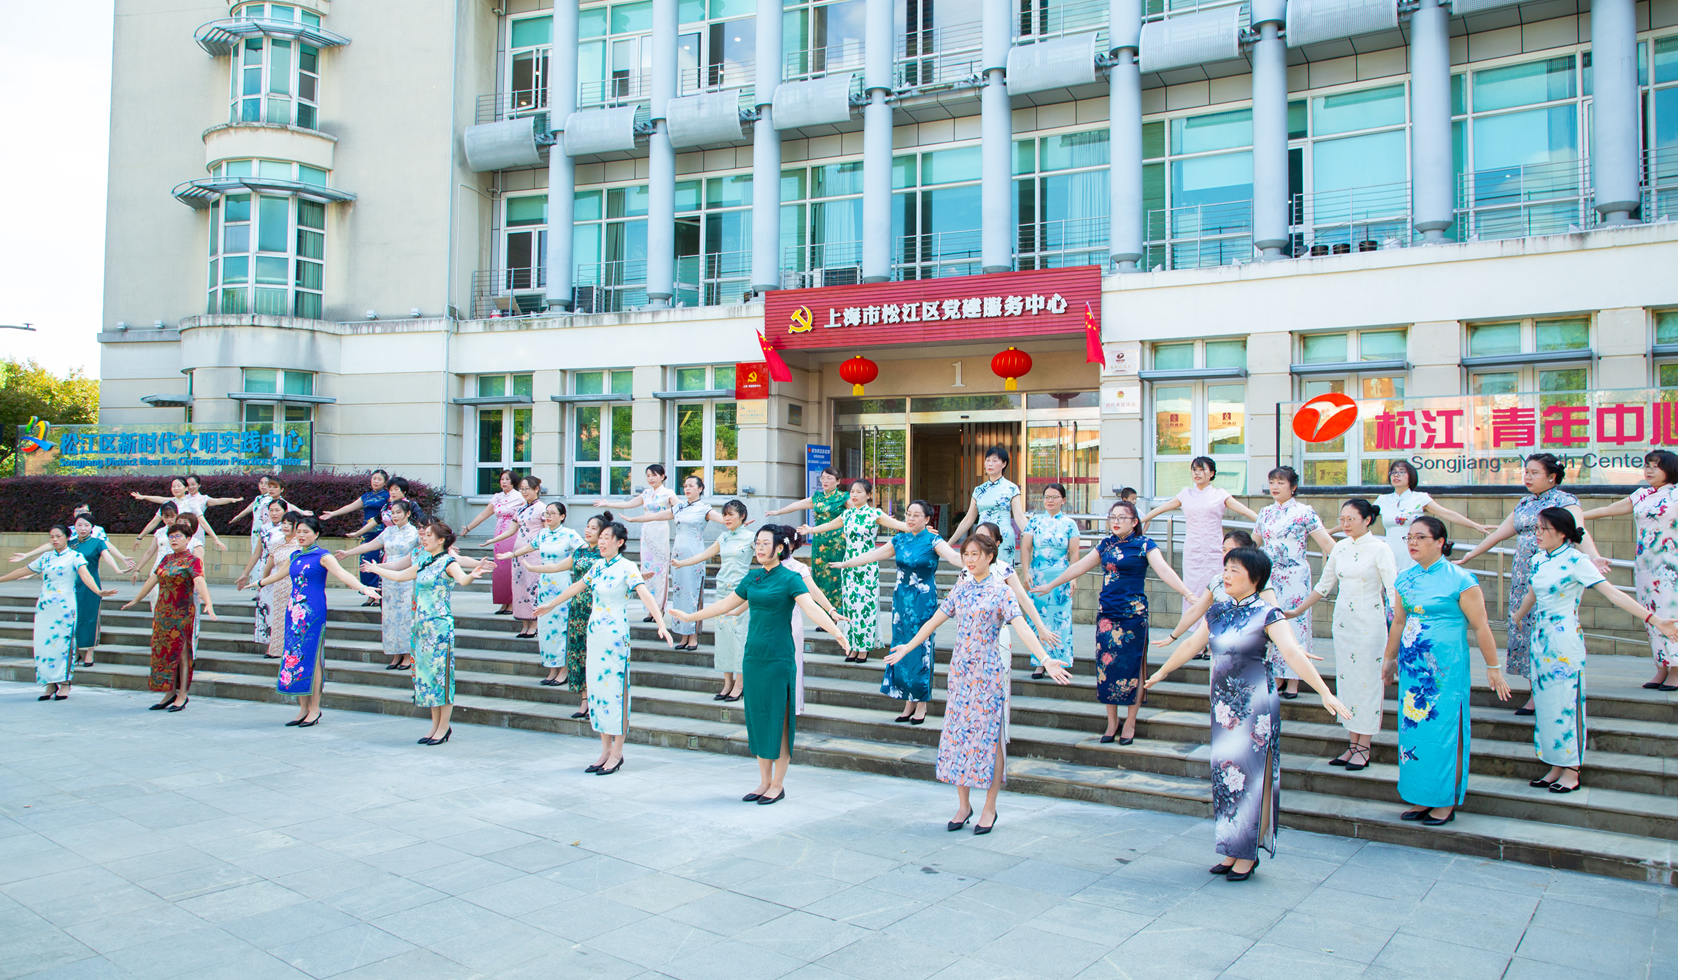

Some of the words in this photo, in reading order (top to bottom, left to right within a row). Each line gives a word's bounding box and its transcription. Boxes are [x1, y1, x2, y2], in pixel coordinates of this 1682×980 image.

[824, 293, 1068, 329] 上海市松江区党建服务中心
[951, 361, 967, 388] 1
[60, 429, 304, 456] 松江区新时代文明实践中心
[60, 457, 104, 469] Songjiang
[105, 457, 138, 467] District
[140, 457, 161, 467] New
[162, 457, 177, 466] Era
[178, 456, 229, 466] Civilization
[231, 456, 269, 466] Practice
[270, 456, 304, 466] Center
[1412, 455, 1501, 474] Songjiang
[1519, 453, 1576, 470] Yth
[1582, 453, 1652, 469] Cente
